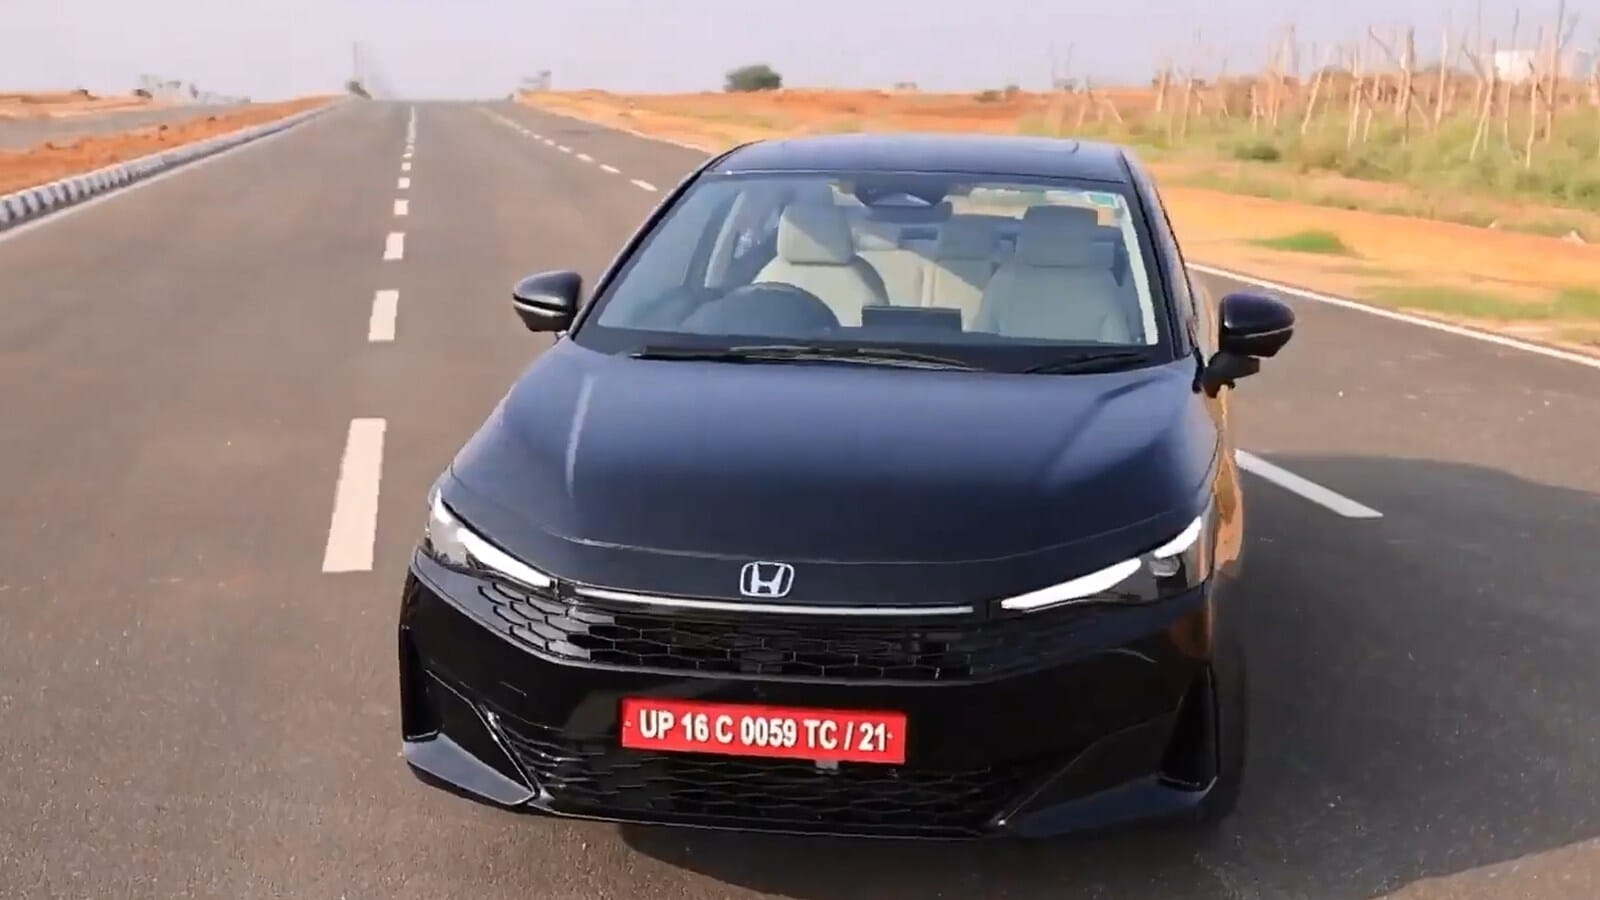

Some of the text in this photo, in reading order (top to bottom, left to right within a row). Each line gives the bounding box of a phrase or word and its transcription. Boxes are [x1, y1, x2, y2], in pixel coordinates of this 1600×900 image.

[639, 709, 886, 752] UP 16 C 0059 TC / 21
